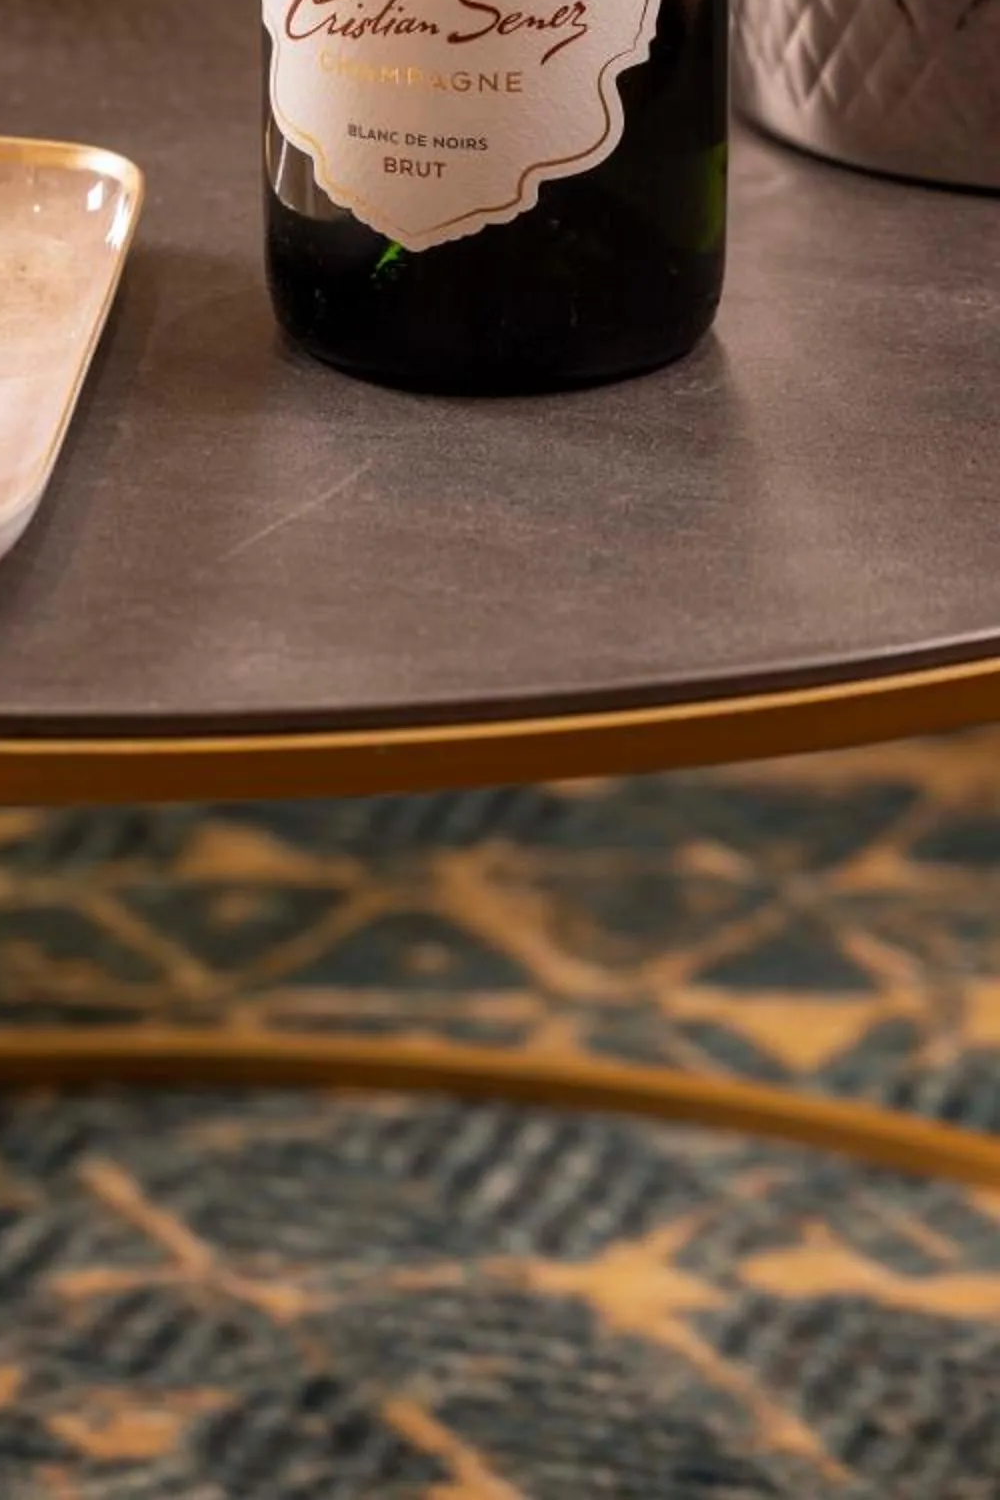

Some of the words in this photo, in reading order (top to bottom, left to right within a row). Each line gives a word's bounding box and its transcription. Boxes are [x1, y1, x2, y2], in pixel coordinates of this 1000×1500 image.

[318, 50, 525, 94] CHAMPAGNE
[347, 123, 400, 147] BLANC
[405, 133, 428, 148] DE
[432, 135, 490, 152] NOIRS
[383, 156, 448, 180] BRUT
